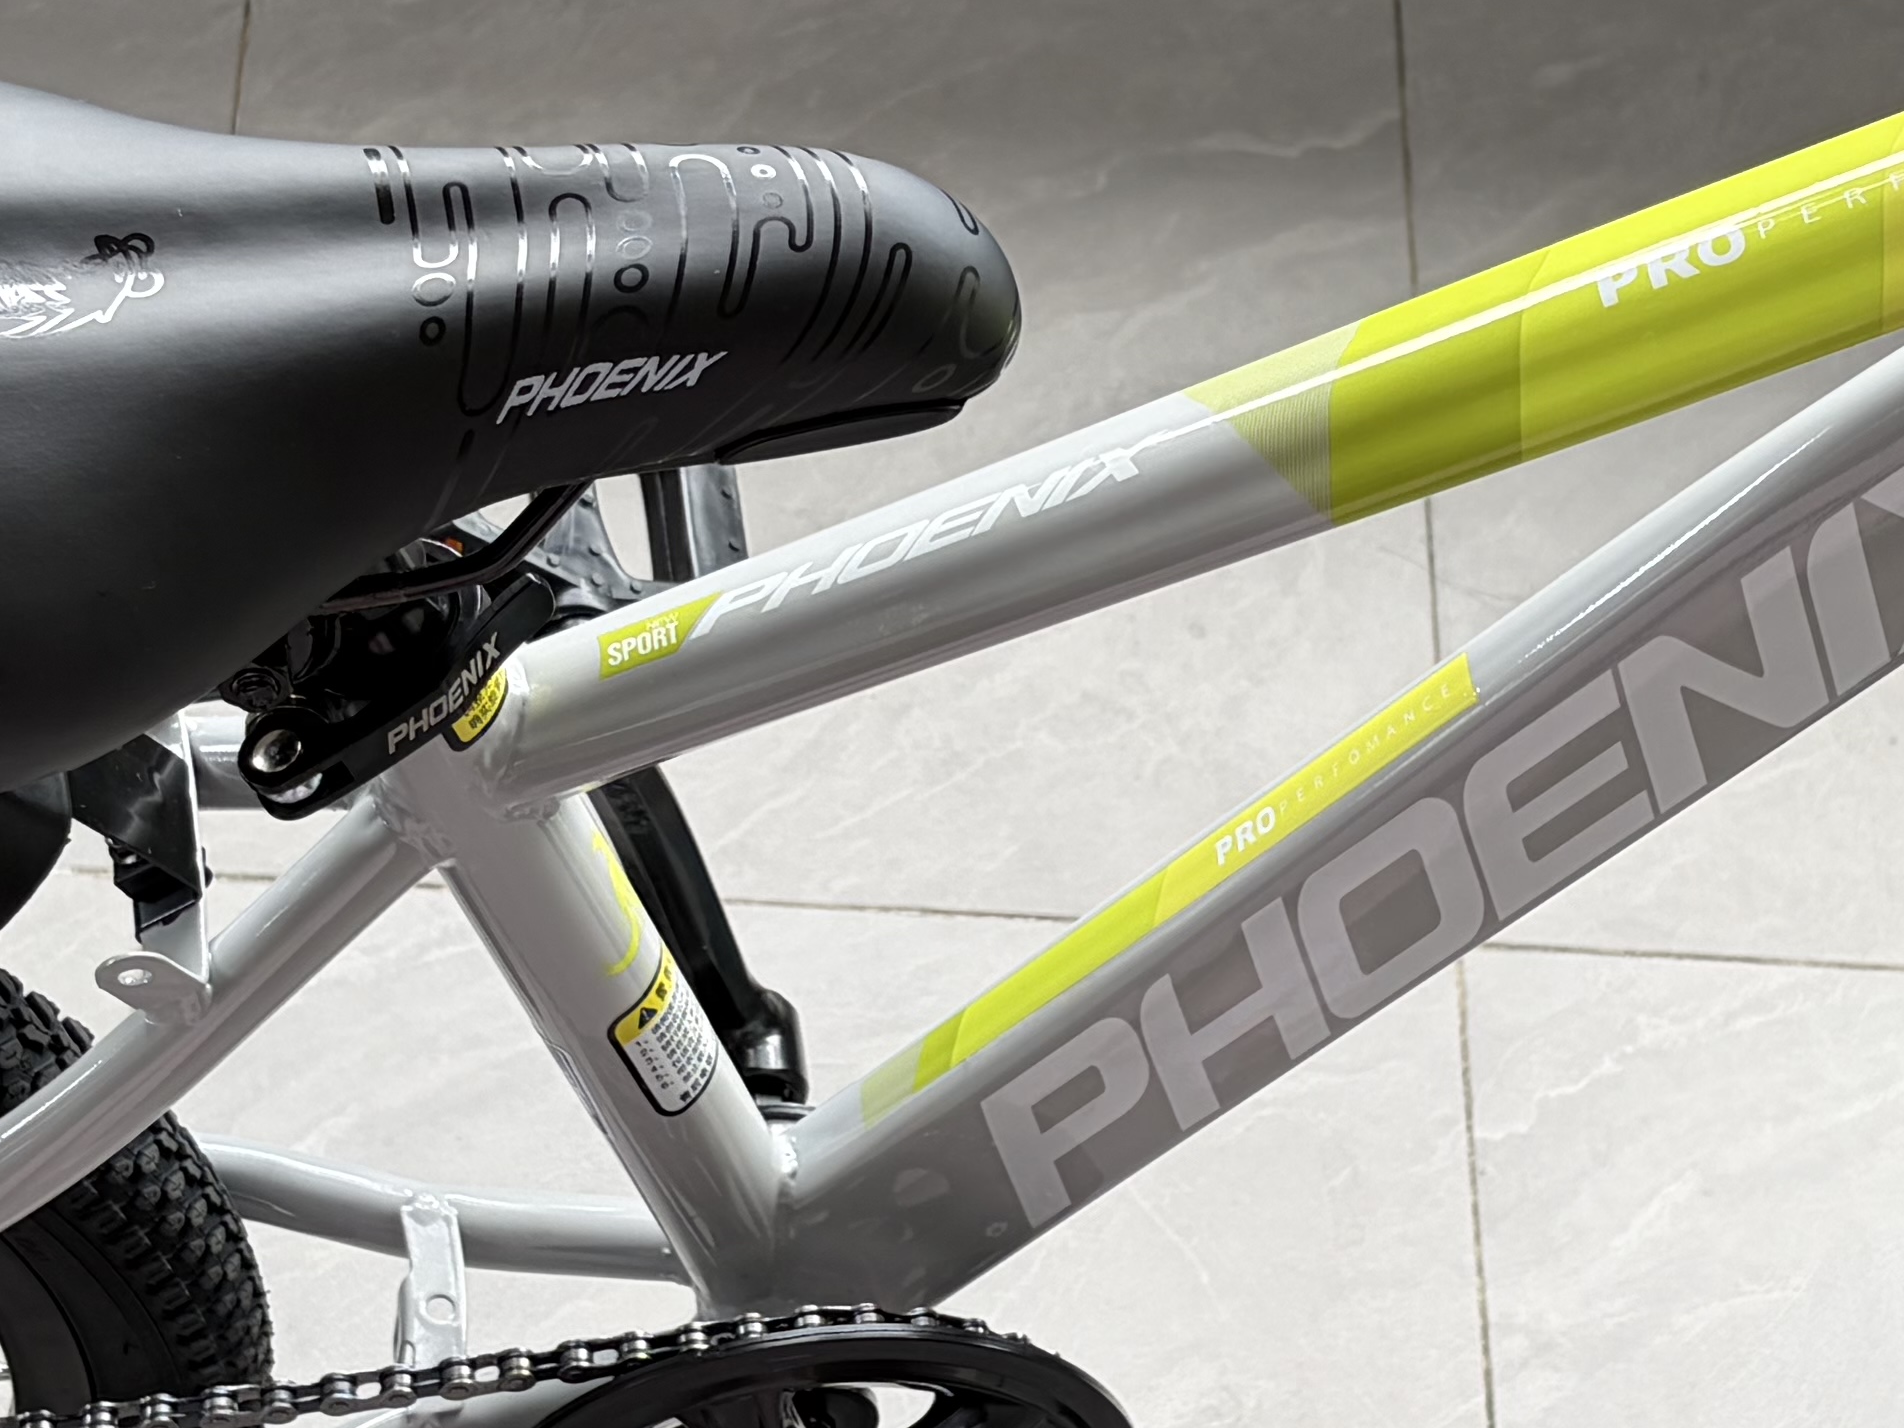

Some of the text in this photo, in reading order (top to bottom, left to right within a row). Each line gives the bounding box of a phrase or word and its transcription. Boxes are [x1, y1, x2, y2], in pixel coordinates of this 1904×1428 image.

[1596, 220, 1747, 308] PRO
[496, 351, 728, 425] PHOENIX
[690, 430, 1166, 639] PHOENIX
[606, 621, 679, 666] SPORT
[387, 631, 501, 755] PHOENIX
[1214, 806, 1276, 866] PRO
